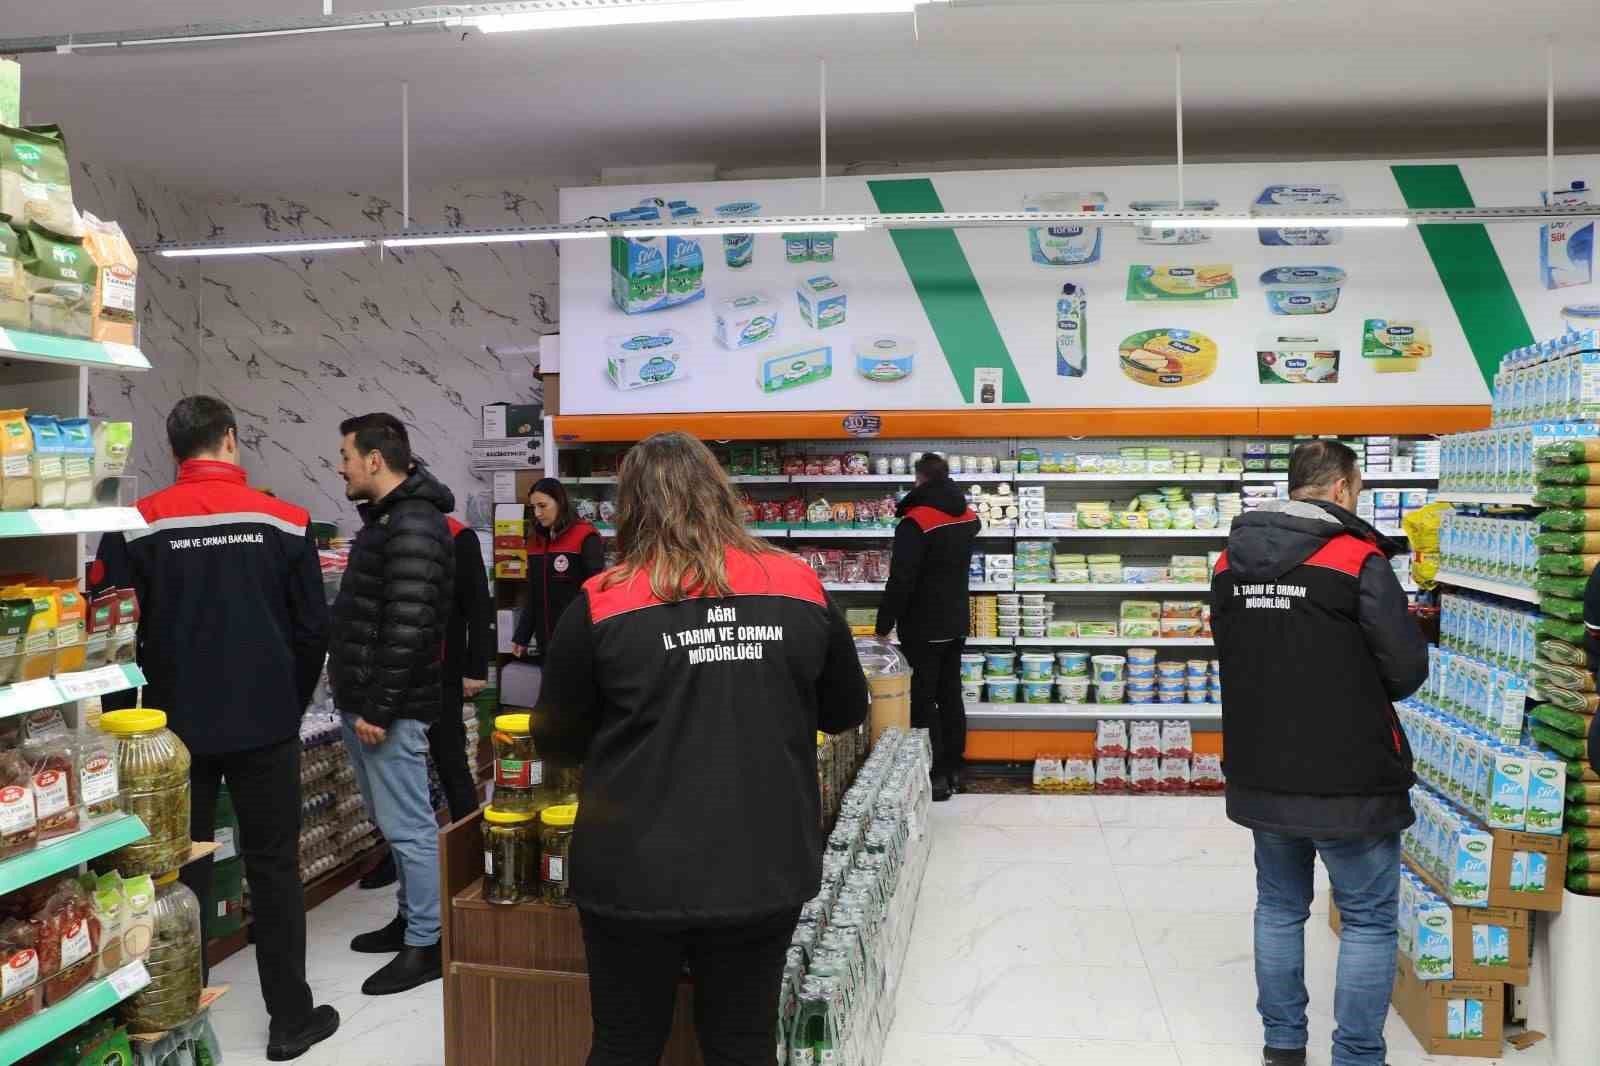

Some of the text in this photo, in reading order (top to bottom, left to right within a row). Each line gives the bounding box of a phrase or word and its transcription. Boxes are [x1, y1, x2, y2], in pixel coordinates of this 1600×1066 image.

[169, 532, 264, 550] TARIM VE ORMAN BAKANLIĞI
[1242, 584, 1265, 596] TARIM
[1265, 585, 1275, 595] VE
[1277, 586, 1306, 597] ORMAN
[1246, 597, 1290, 608] MÜDÜRLÜĞÜ
[707, 606, 736, 622] AĞRI
[662, 626, 783, 650] İL TARIM VE ORMAN
[689, 643, 762, 664] MÜDÜRLÜĞÜ
